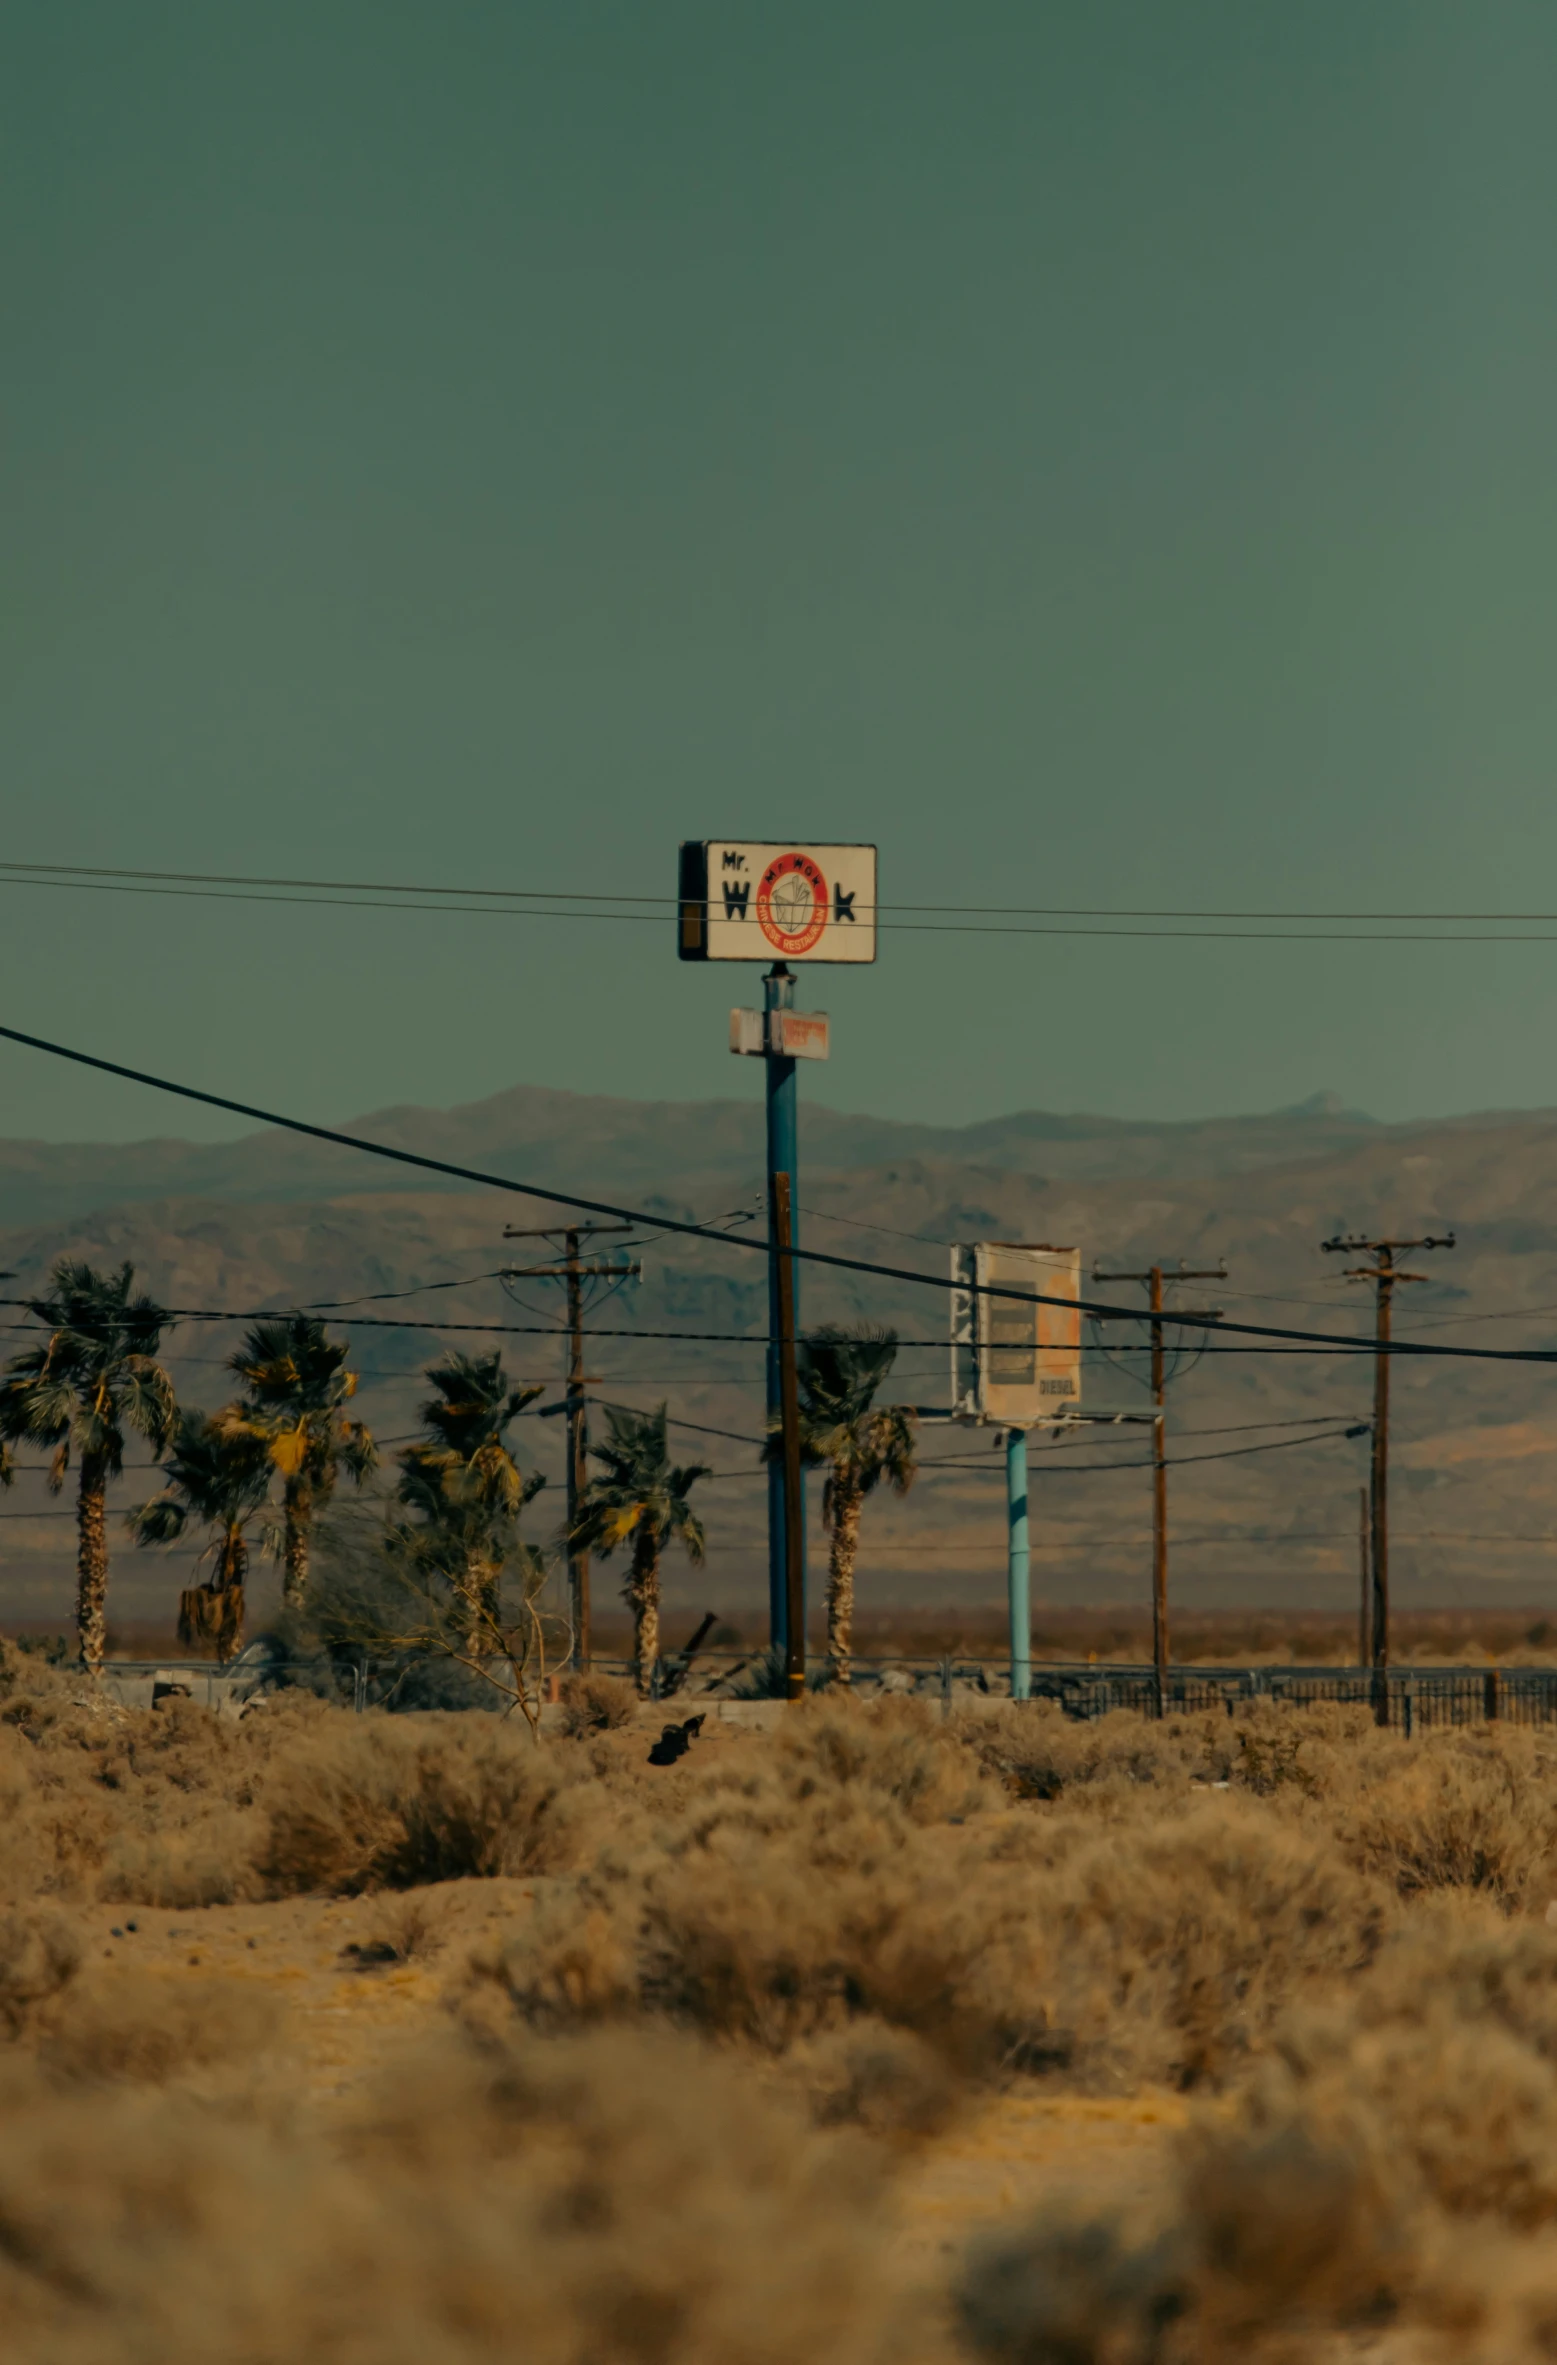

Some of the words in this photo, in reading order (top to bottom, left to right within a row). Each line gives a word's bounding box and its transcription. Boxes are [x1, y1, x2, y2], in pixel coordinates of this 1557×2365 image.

[722, 850, 749, 872] Mr.
[793, 856, 821, 889] WOK
[758, 894, 782, 944] CHINESE
[782, 901, 826, 951] RESTAURANT
[1039, 1379, 1076, 1396] DIESEL
